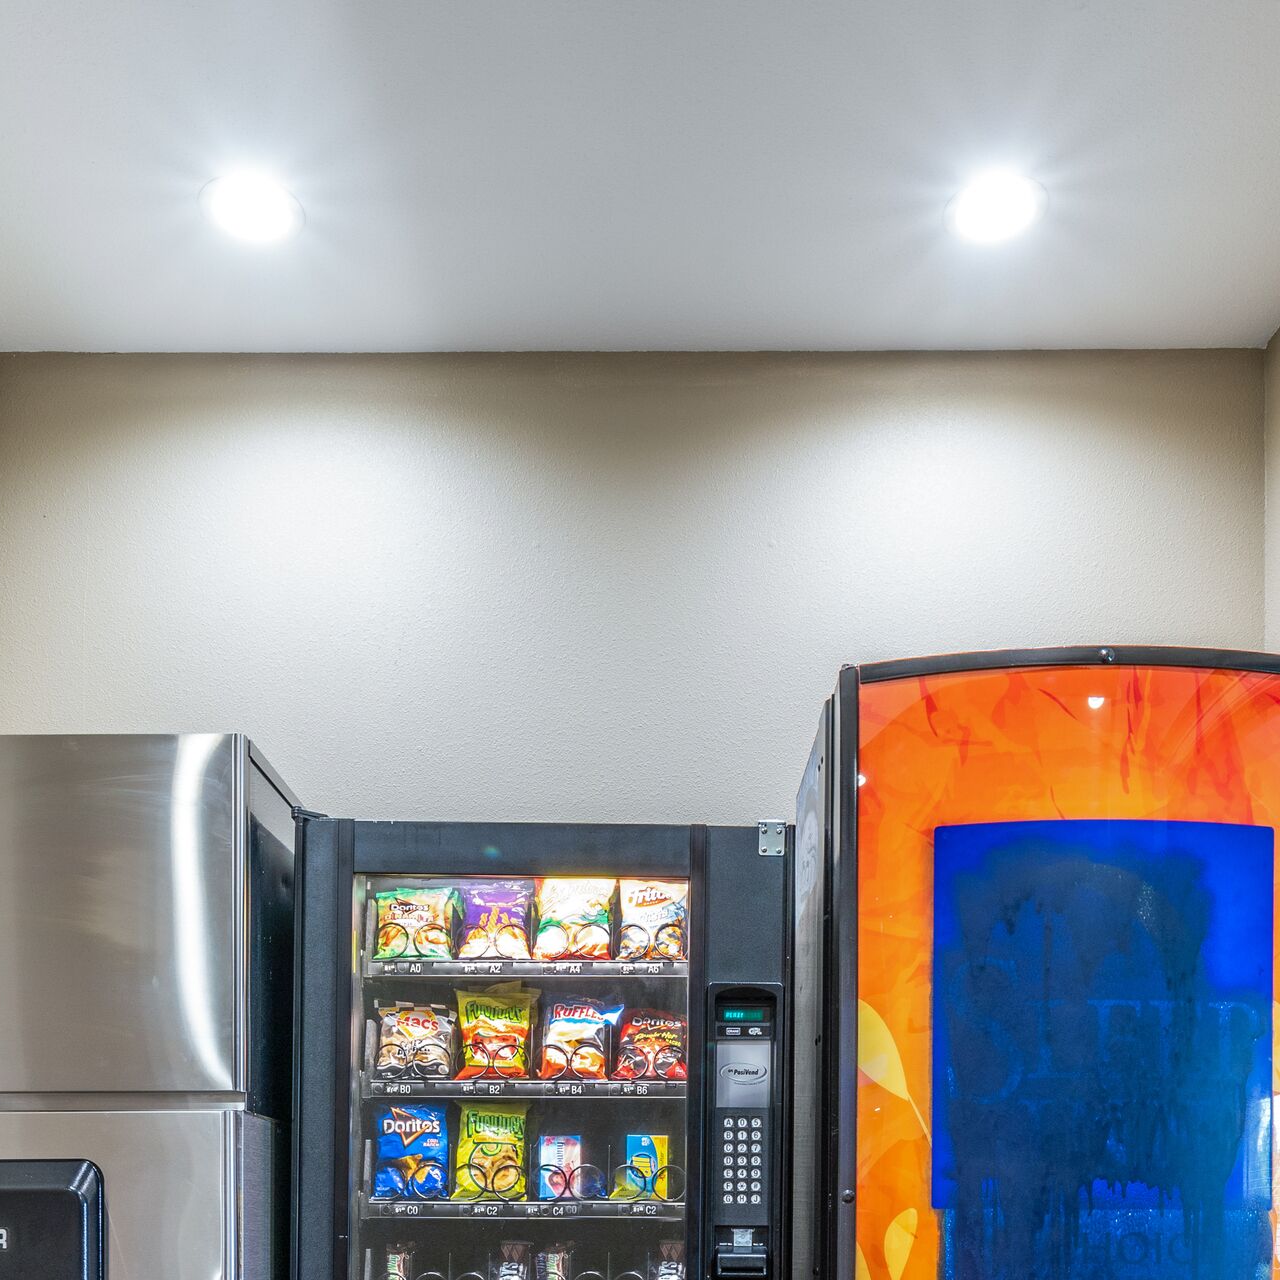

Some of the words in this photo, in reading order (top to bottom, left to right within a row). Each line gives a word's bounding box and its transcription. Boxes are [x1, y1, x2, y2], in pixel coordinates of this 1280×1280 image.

[410, 963, 421, 973] A0
[489, 963, 501, 973] A2
[631, 1016, 682, 1027] Doritos
[400, 1085, 411, 1094] B0
[489, 1085, 500, 1094] B2
[571, 1086, 582, 1094] B4
[636, 1086, 648, 1094] B6
[383, 1118, 440, 1134] Doritos
[407, 1206, 418, 1215] C0
[486, 1206, 498, 1215] C2
[552, 1206, 564, 1216] C4
[645, 1206, 657, 1215] C2
